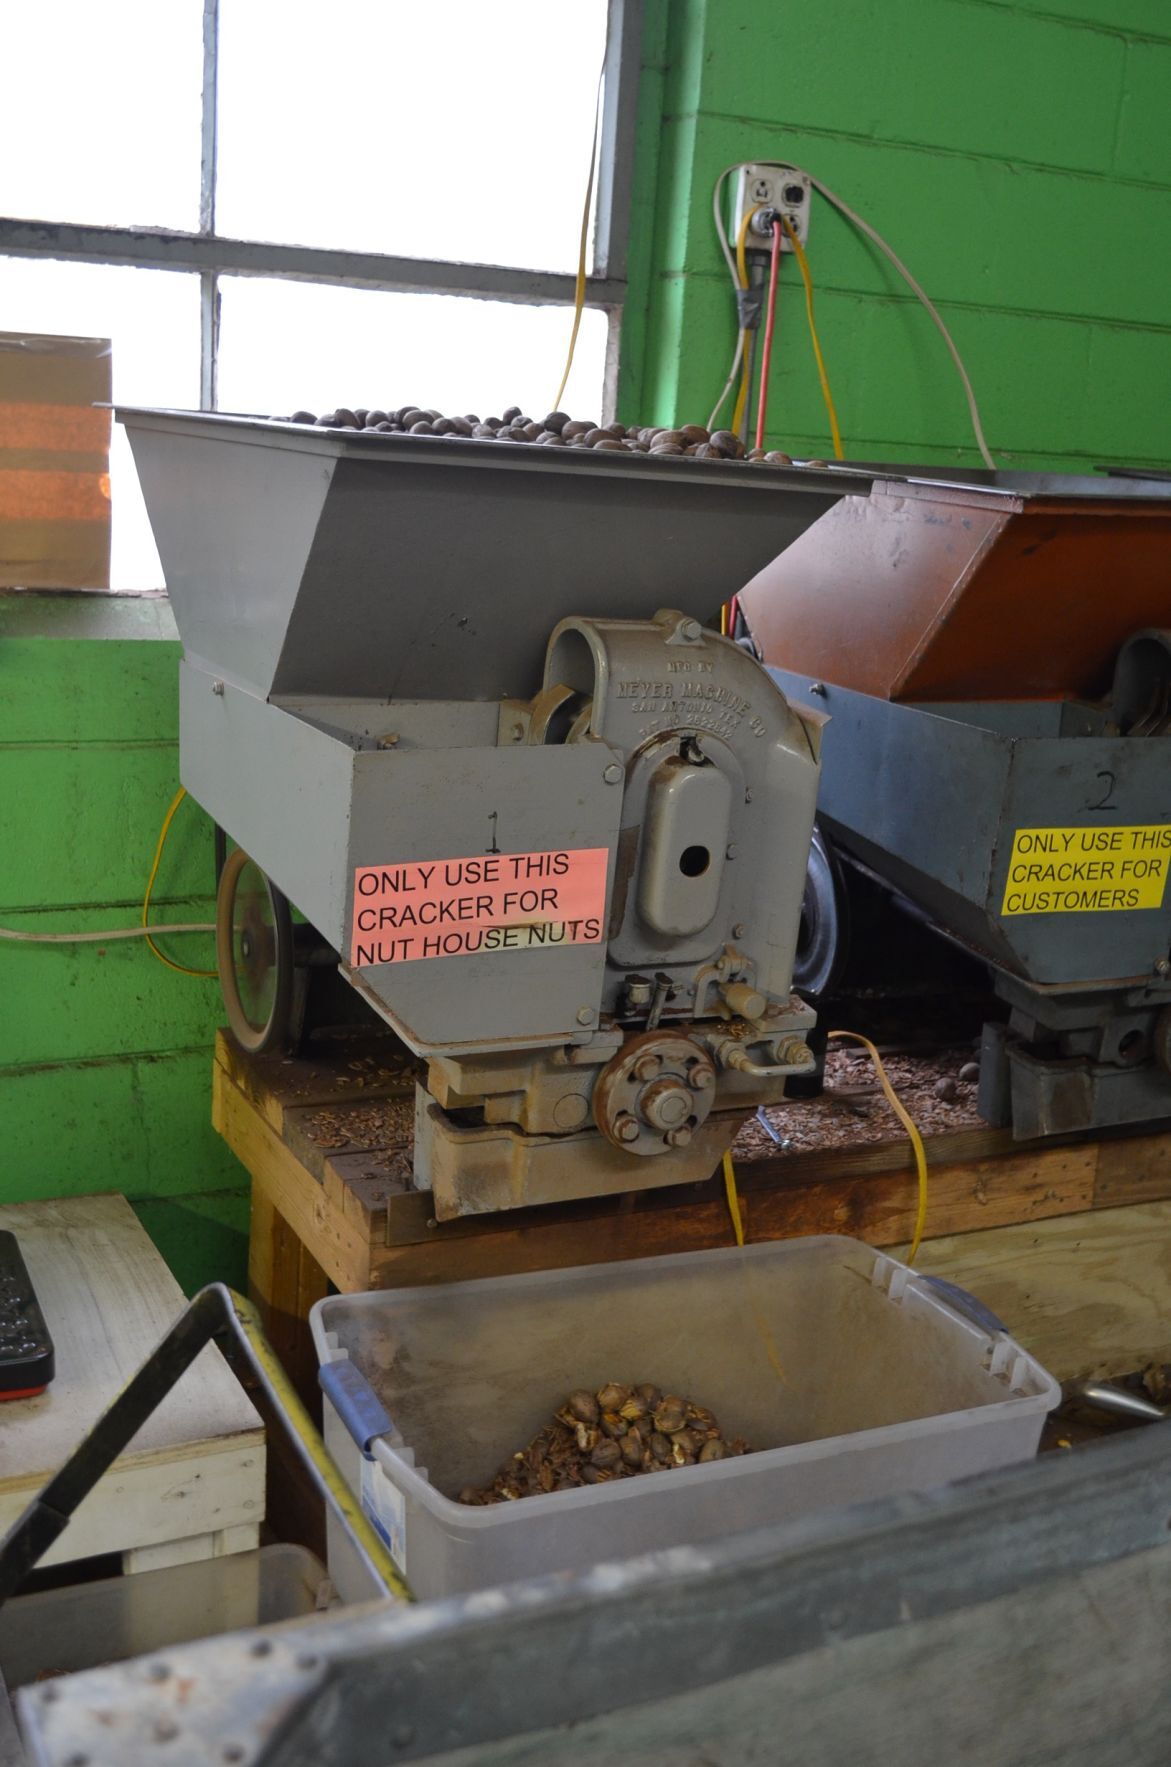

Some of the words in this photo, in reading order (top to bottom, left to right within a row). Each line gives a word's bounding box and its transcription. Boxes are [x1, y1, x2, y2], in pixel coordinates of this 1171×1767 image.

[616, 680, 674, 699] MEYER
[631, 701, 657, 713] SAN
[1088, 771, 1117, 810] 2
[485, 811, 501, 854] 1
[1017, 833, 1075, 854] ONLY
[1081, 832, 1124, 851] USE
[1131, 830, 1171, 849] THIS
[358, 866, 435, 896] ONLY
[445, 859, 500, 887] USE
[509, 853, 569, 880] THIS
[1012, 861, 1115, 883] CRACKER
[1120, 859, 1162, 879] FOR
[357, 895, 494, 932] CRACKER
[503, 888, 558, 915] FOR
[1007, 889, 1140, 912] CUSTOMERS
[356, 938, 414, 967] NUT
[423, 929, 519, 957] HOUSE
[528, 918, 600, 945] NUTS
